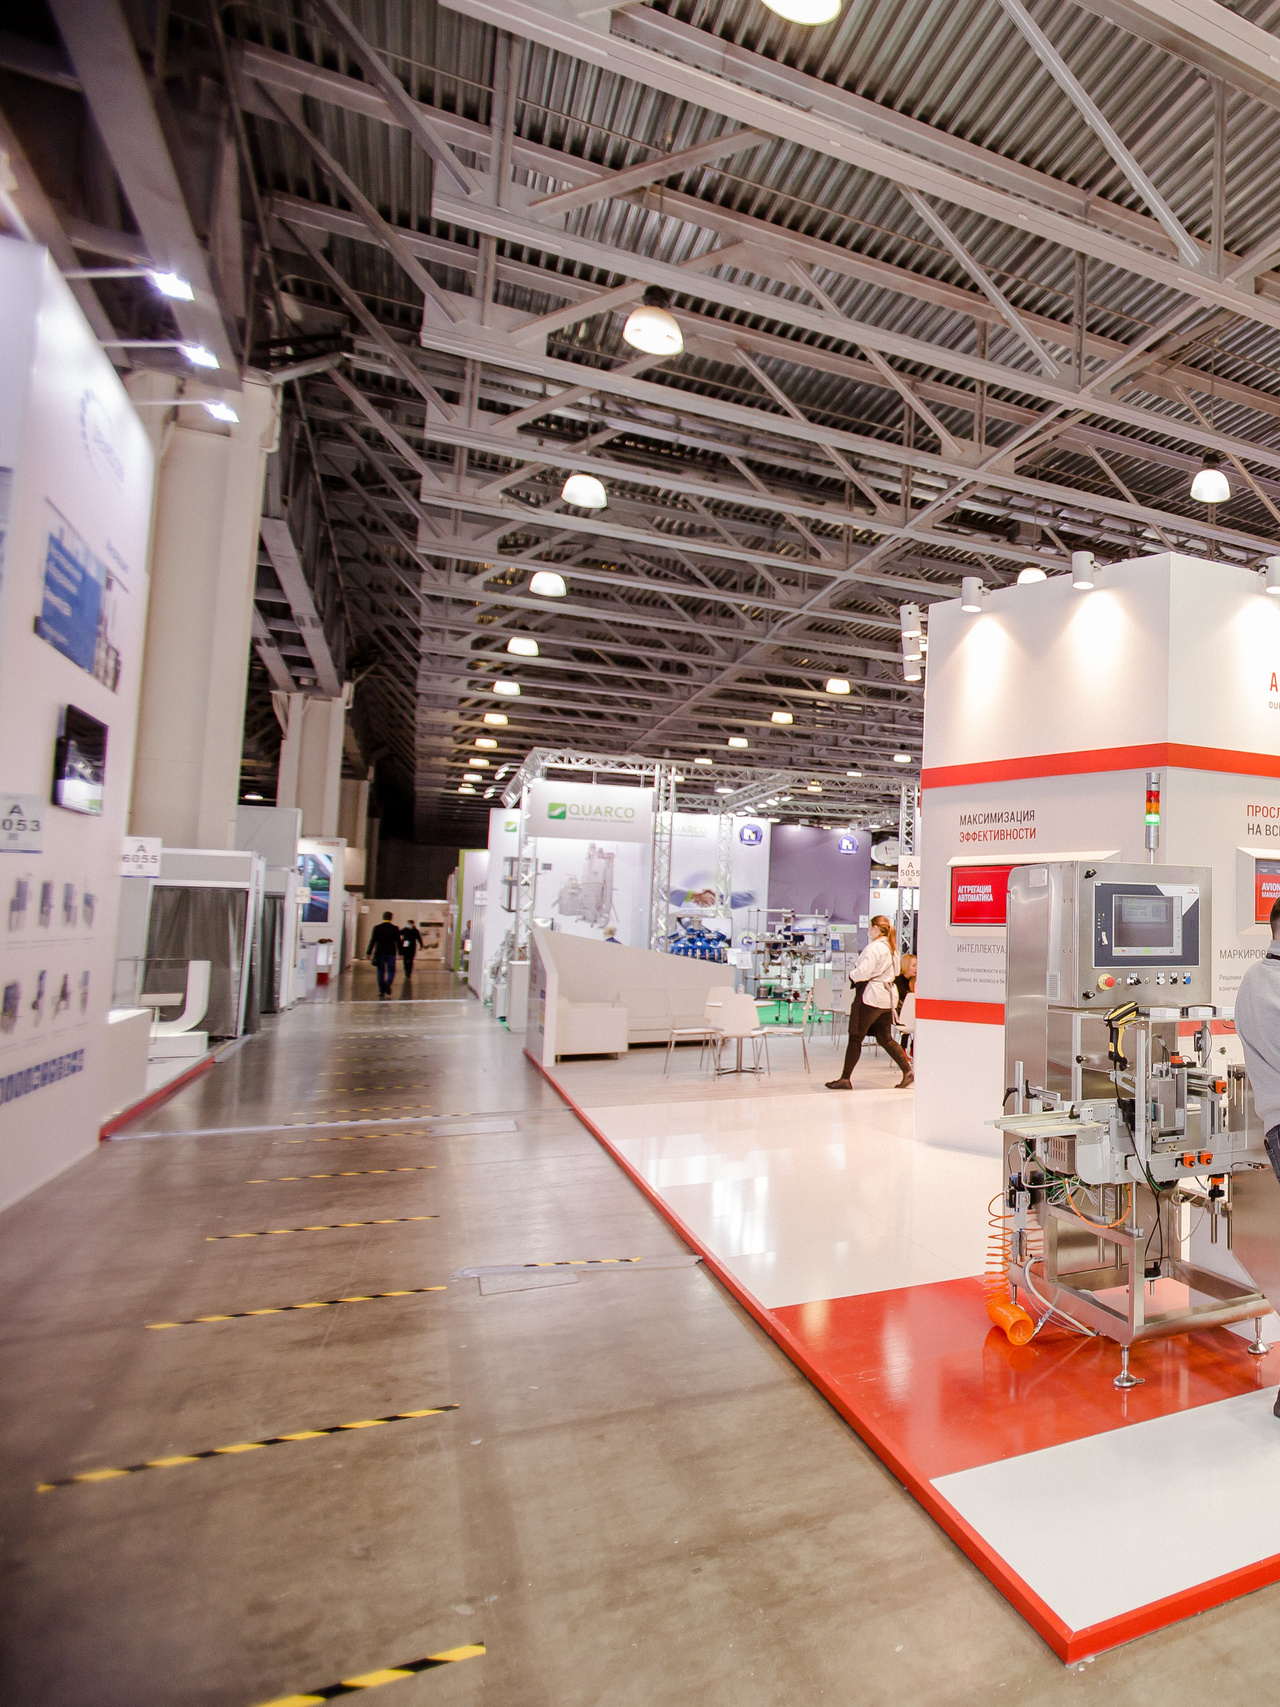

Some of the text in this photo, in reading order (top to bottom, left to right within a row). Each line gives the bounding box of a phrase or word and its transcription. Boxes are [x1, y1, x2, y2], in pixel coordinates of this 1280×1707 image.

[9, 804, 24, 816] A
[568, 803, 635, 819] QUARCO
[959, 809, 1035, 826] МАКСИМИЗАЦИЯ
[1, 818, 41, 832] 053
[673, 825, 707, 835] UARCO
[1247, 823, 1262, 836] НА
[959, 827, 1036, 843] ЭФФЕКТИВНОСТИ
[136, 844, 146, 853] A
[122, 854, 159, 864] 6055
[900, 869, 921, 877] 5055
[957, 893, 994, 902] АВТОМАТИКА
[956, 944, 1006, 954] ИНТЕЛЛЕКТУА
[1218, 949, 1267, 960] МАРКИРОВ
